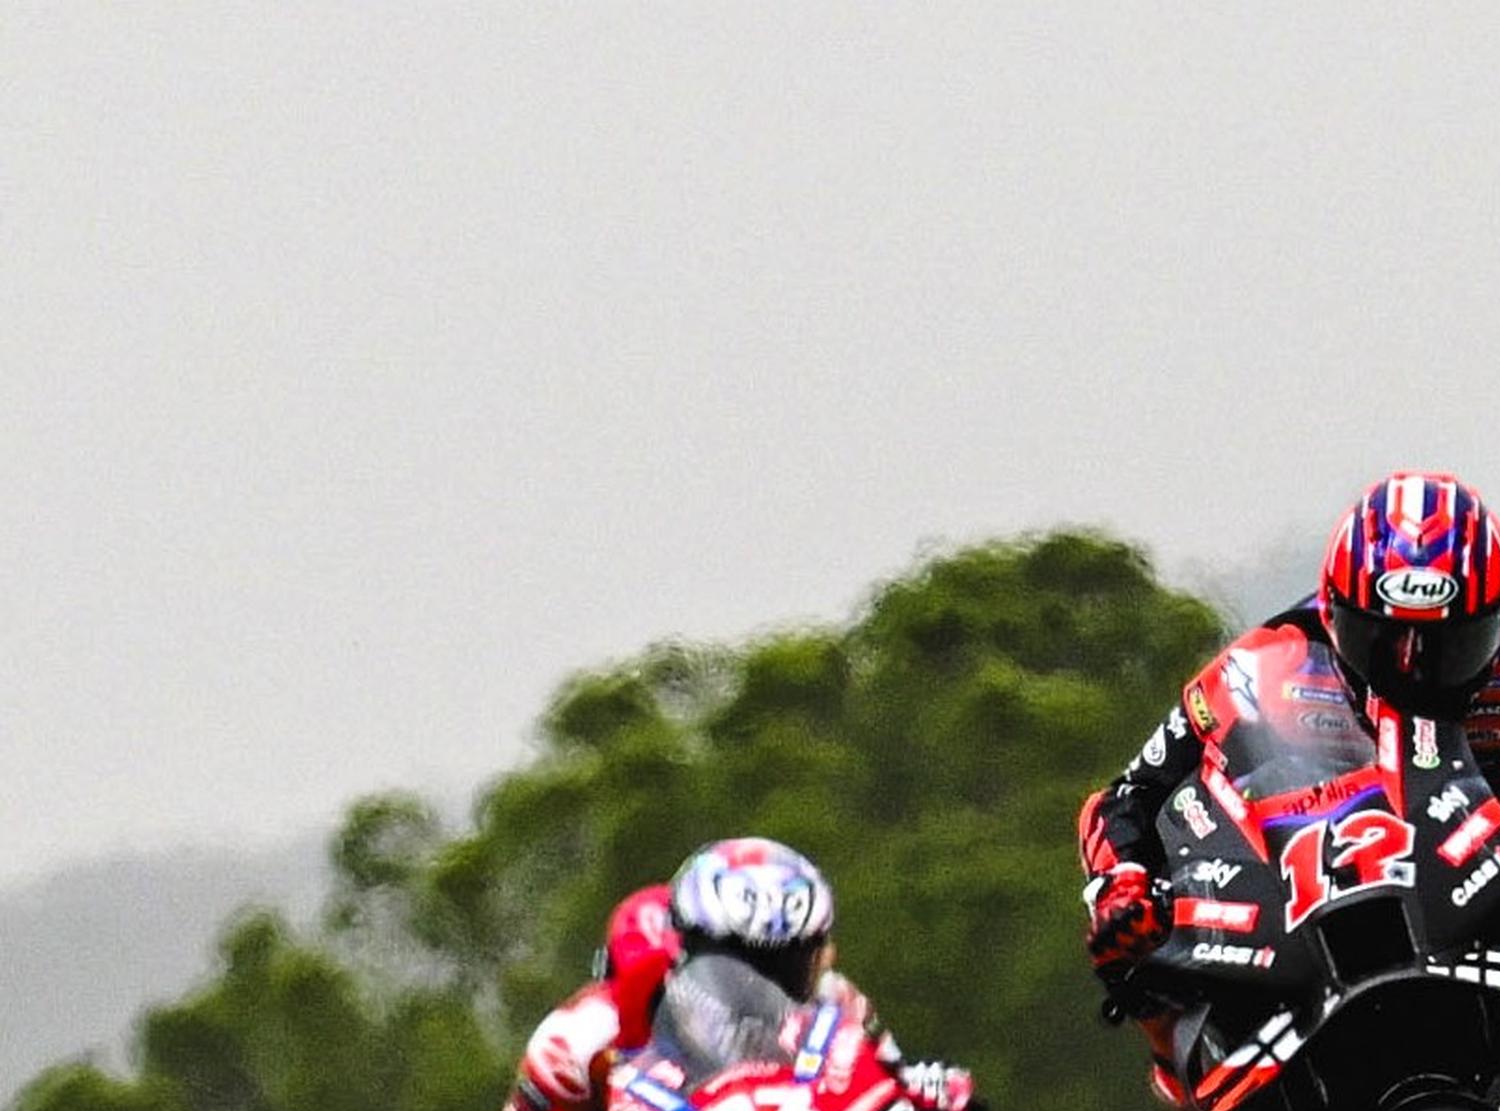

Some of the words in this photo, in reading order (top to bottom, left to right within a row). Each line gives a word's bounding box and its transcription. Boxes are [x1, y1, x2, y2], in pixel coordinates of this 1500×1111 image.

[1193, 858, 1242, 889] sky
[1280, 808, 1416, 934] 12
[1451, 859, 1499, 907] CASE
[1192, 942, 1254, 966] CASE
